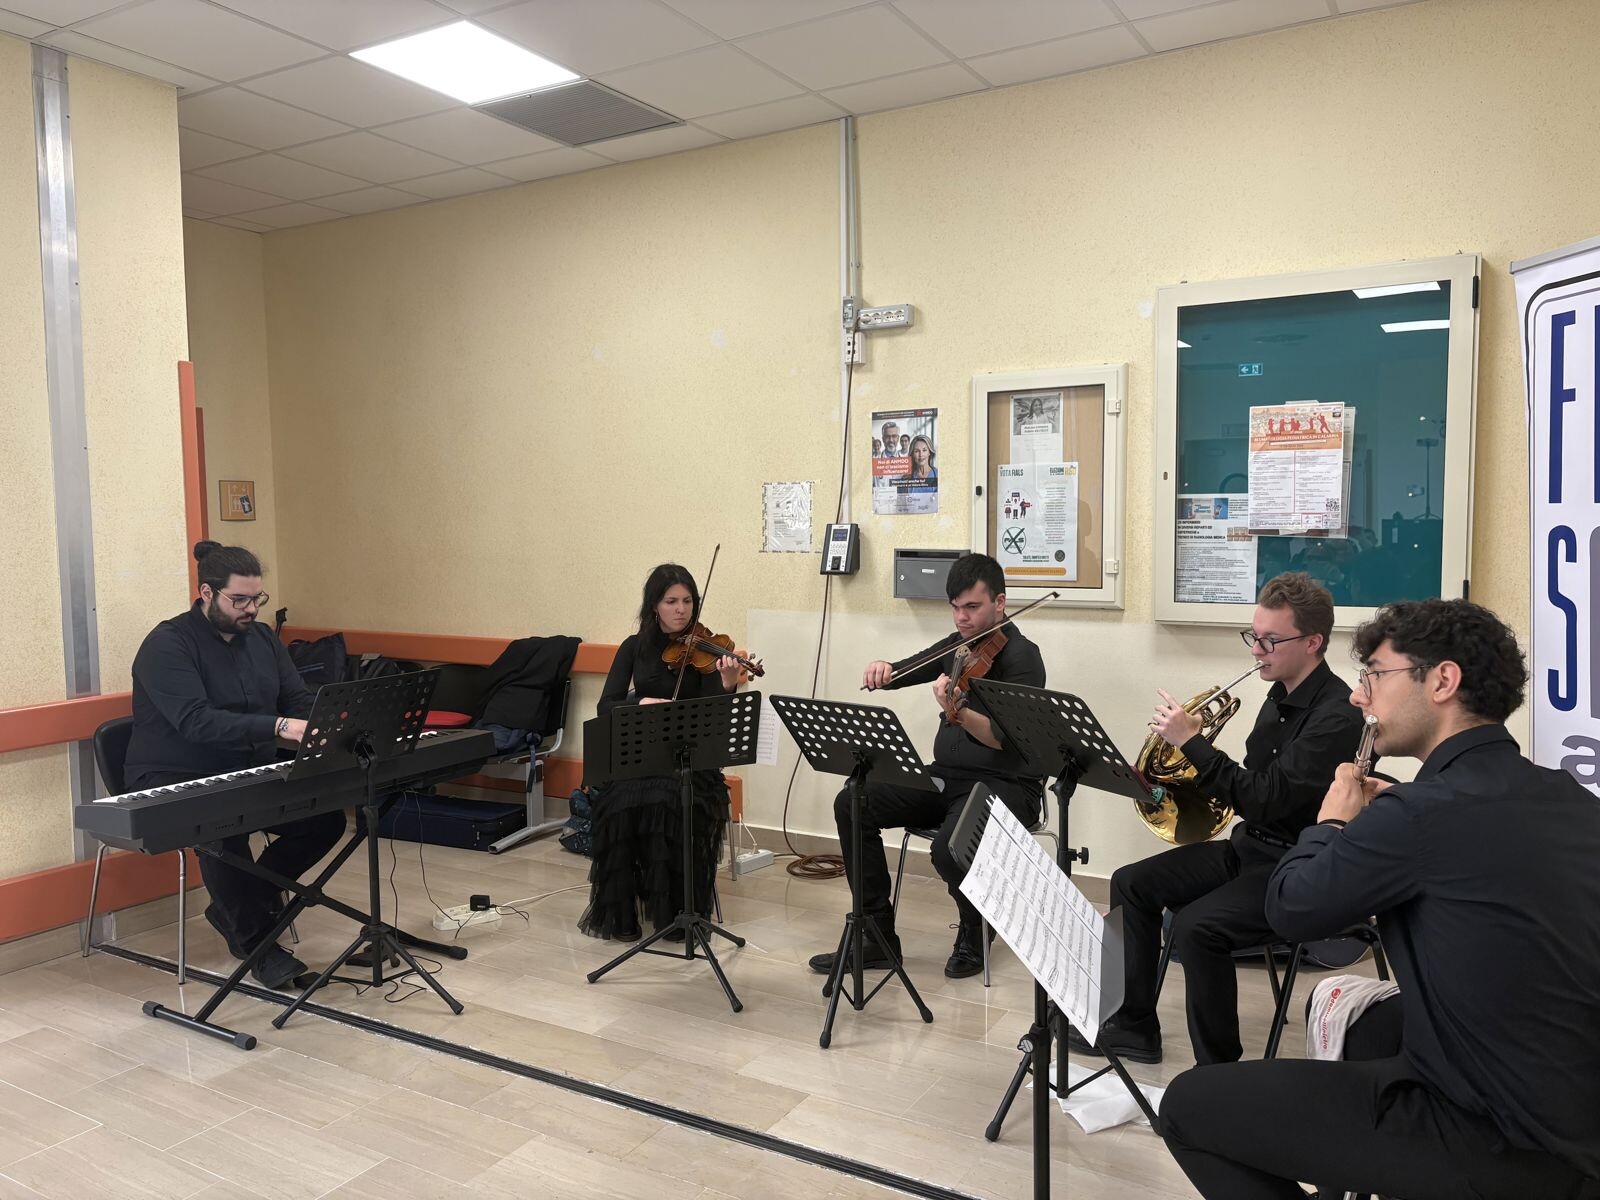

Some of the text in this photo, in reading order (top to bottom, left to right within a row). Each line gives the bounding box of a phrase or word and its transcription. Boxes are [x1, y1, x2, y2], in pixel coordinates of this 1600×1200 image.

[1000, 469, 1024, 477] VOTA FIALS
[1549, 306, 1600, 504] F
[1547, 525, 1600, 719] S
